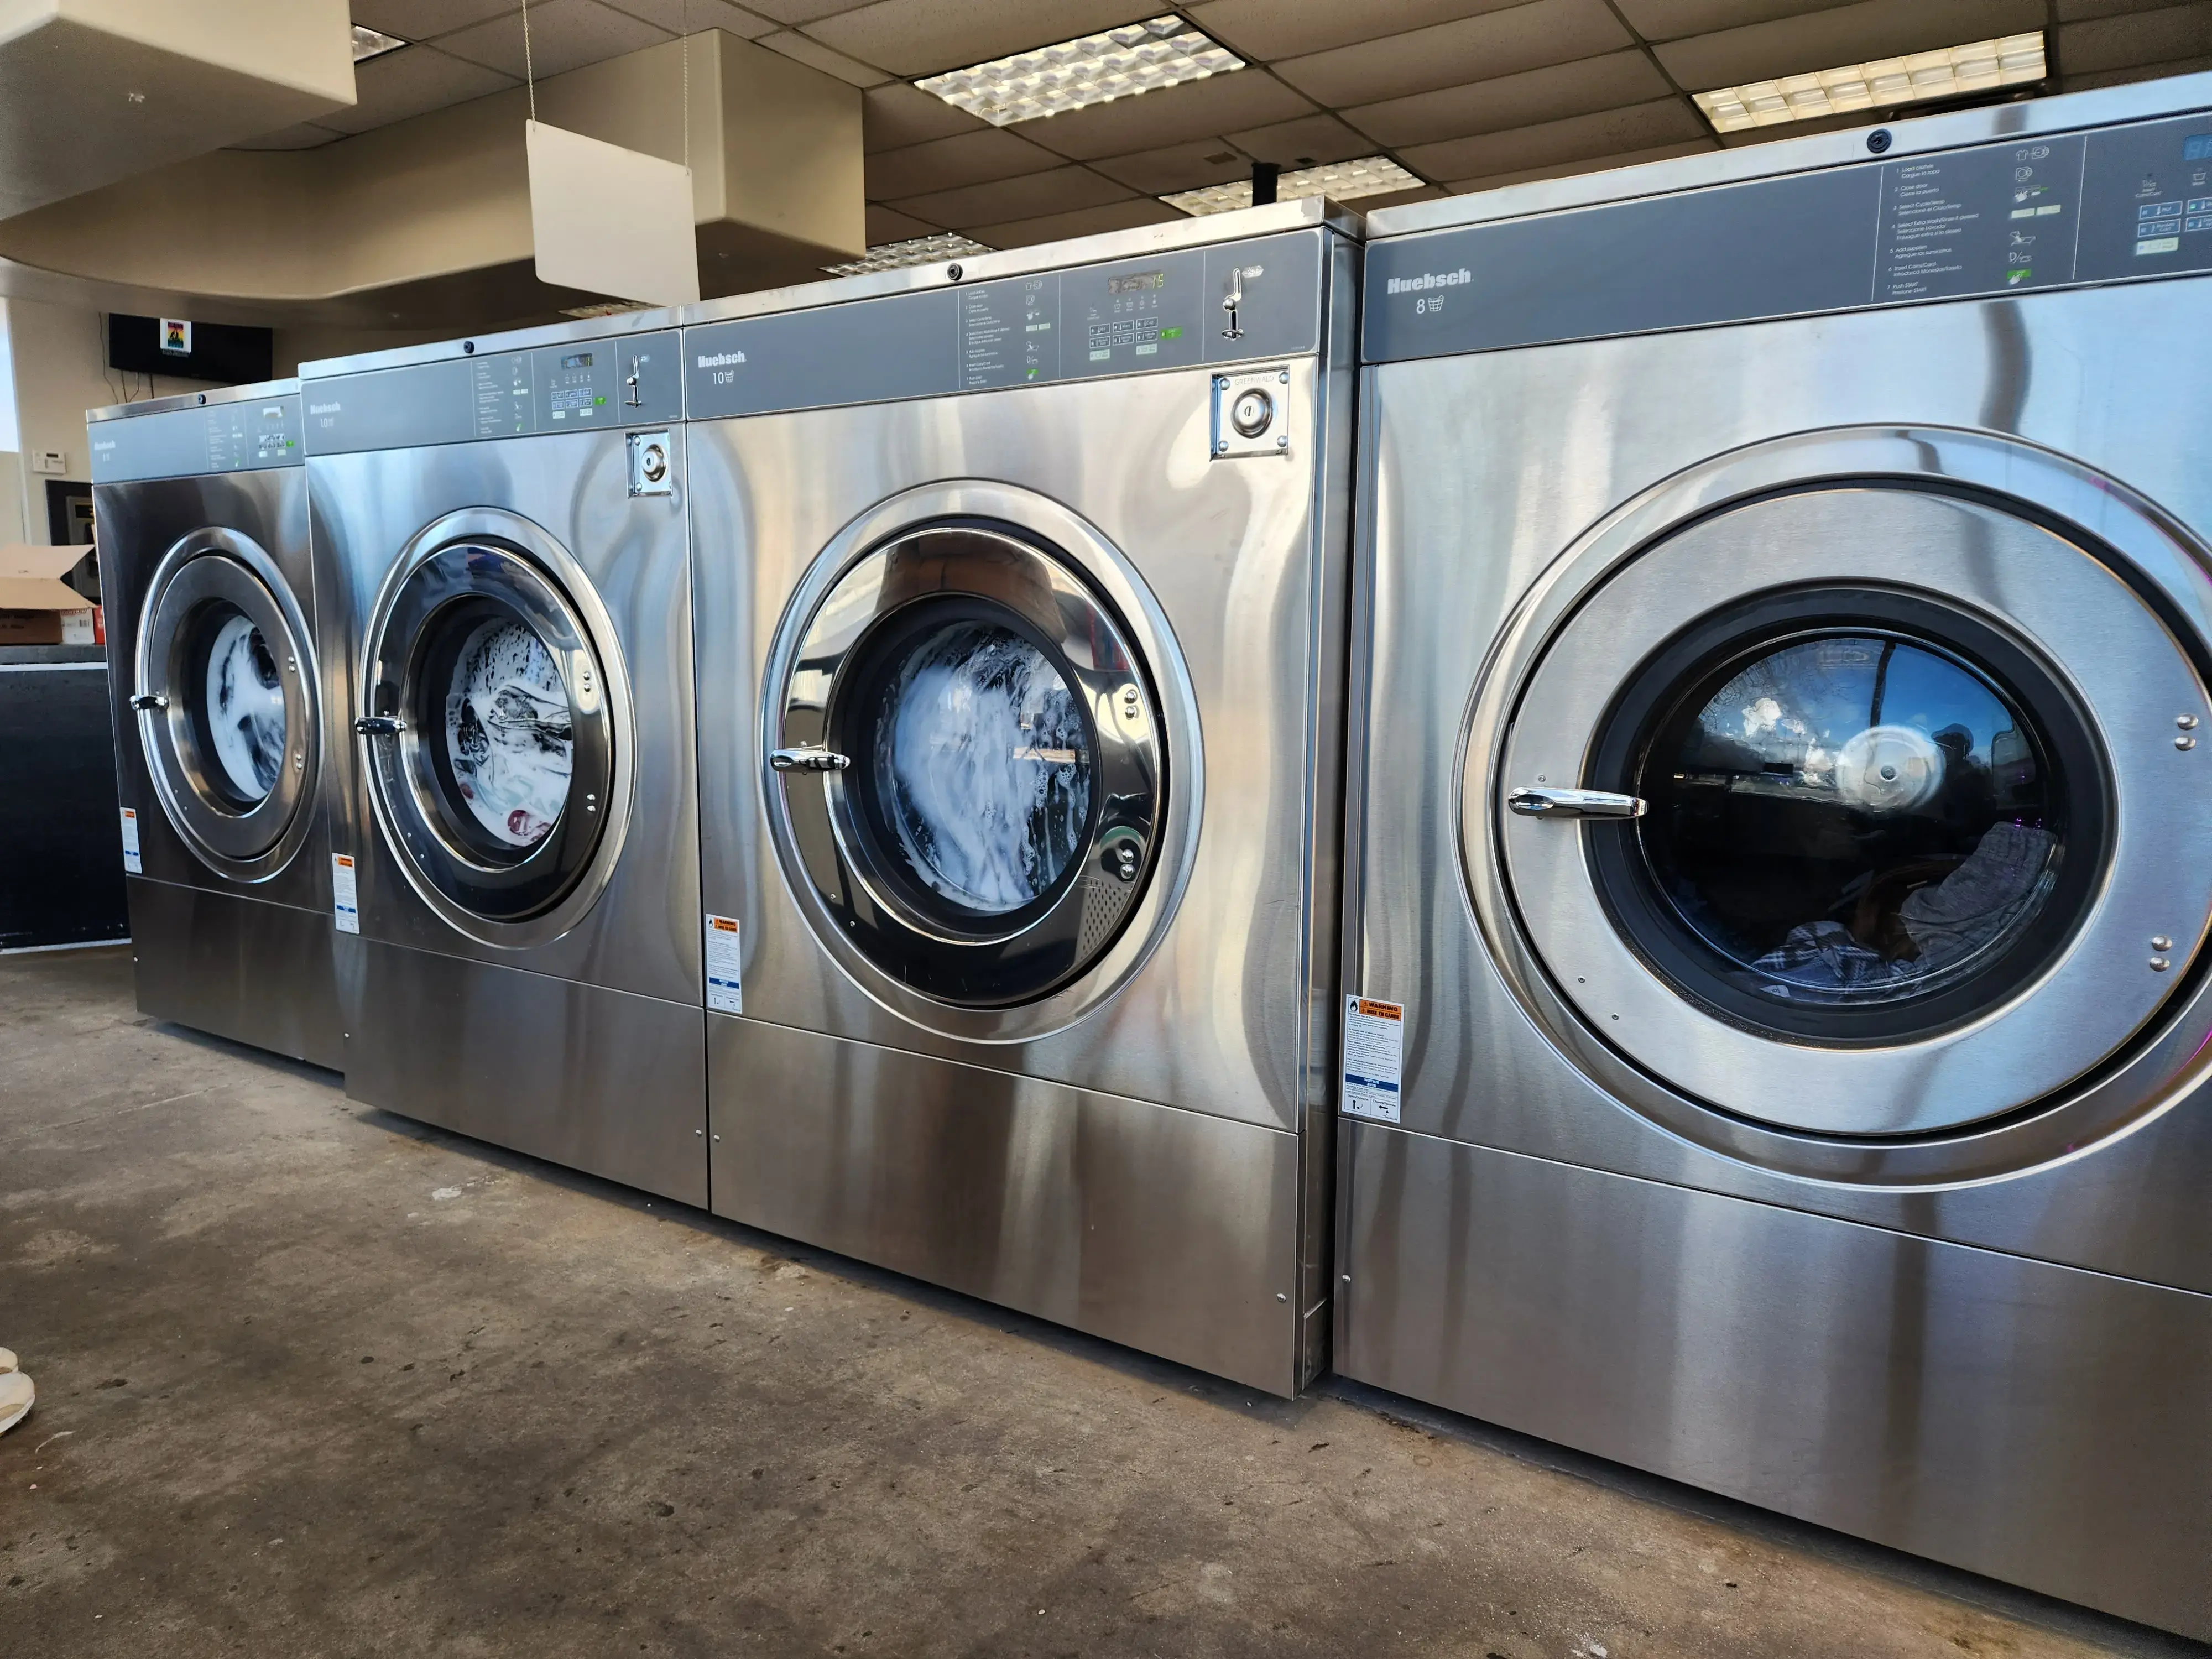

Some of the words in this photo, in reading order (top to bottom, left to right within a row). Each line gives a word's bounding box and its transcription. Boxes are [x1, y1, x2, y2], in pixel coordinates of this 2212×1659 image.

[1387, 268, 1471, 294] Huebsch
[1416, 299, 1425, 314] 8
[698, 351, 745, 368] Huebsch
[713, 372, 724, 384] 10
[1234, 375, 1274, 385] GREENWALD
[1369, 1002, 1398, 1012] WARNING
